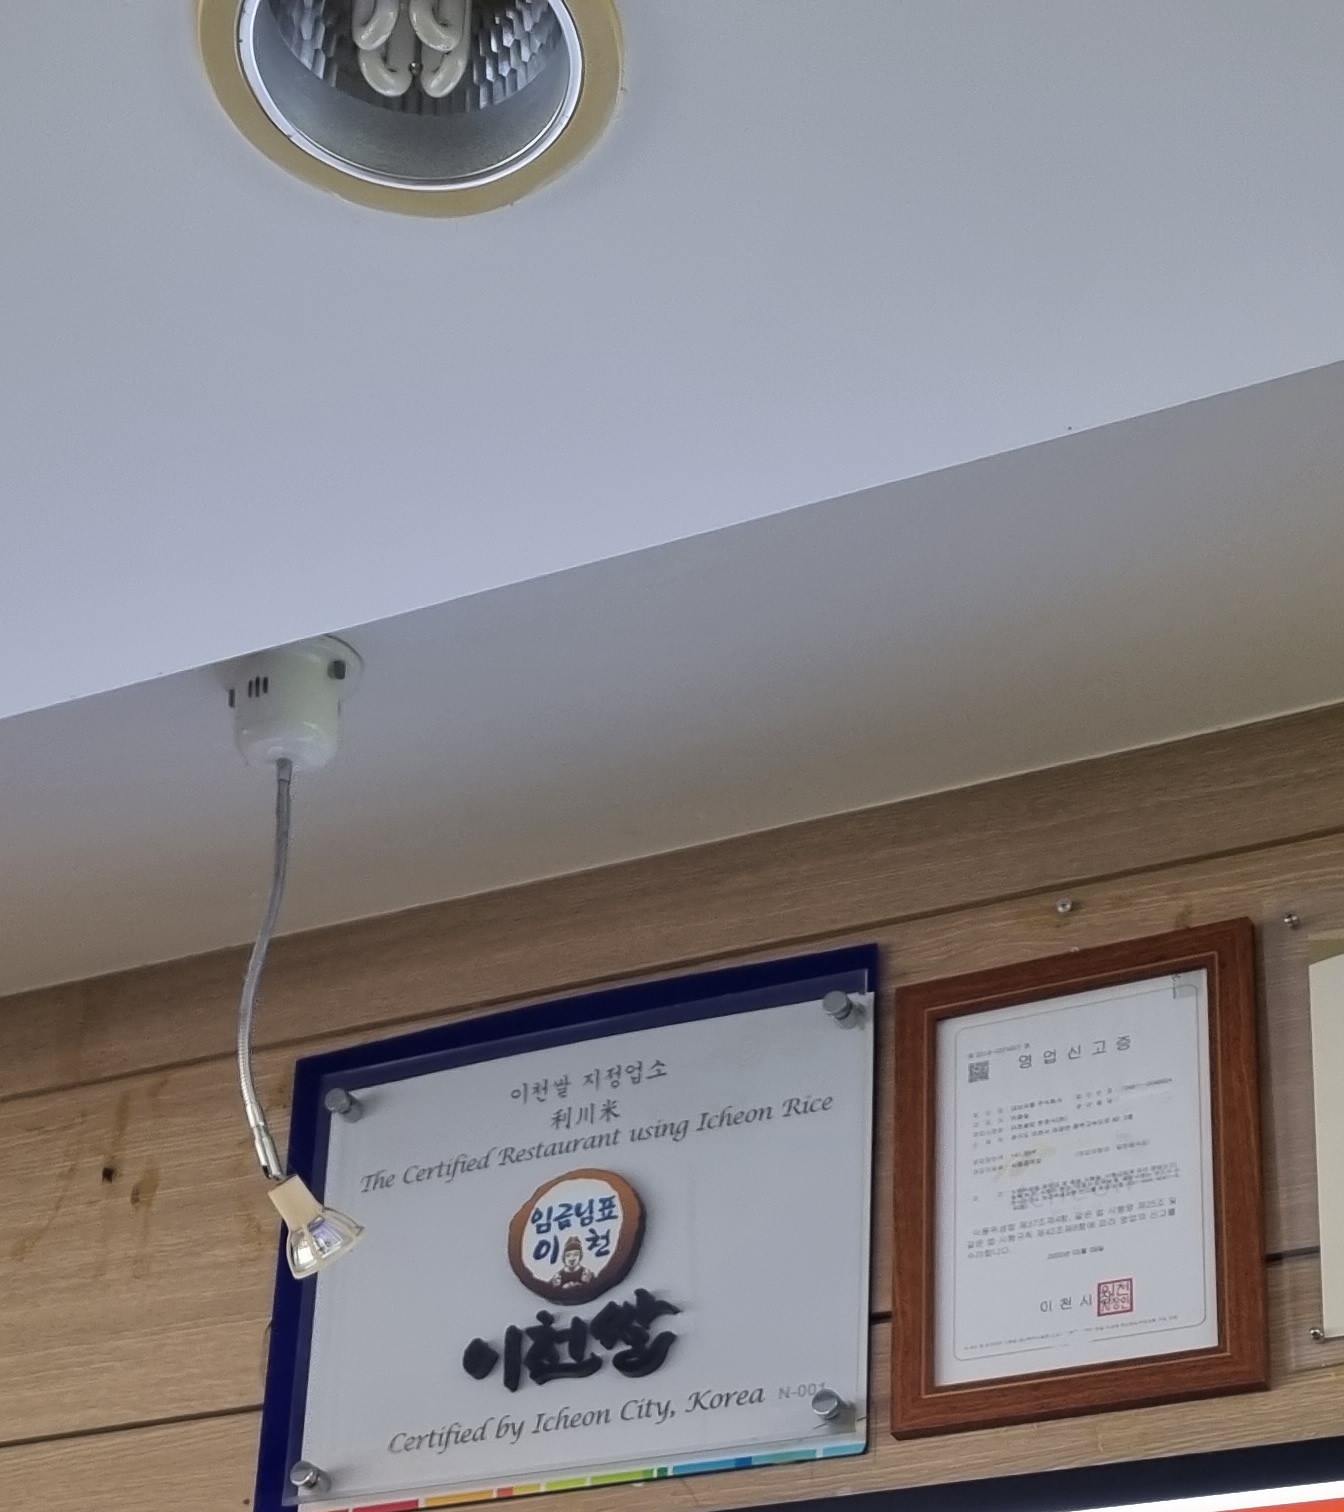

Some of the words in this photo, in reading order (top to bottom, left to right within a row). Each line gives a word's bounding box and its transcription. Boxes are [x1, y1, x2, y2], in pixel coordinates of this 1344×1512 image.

[510, 1076, 571, 1104] 이천쌀
[582, 1059, 667, 1090] 지정업소
[360, 1169, 396, 1193] The
[403, 1152, 490, 1188] Certified
[498, 1128, 621, 1167] Restaurant
[628, 1118, 688, 1145] using
[696, 1103, 773, 1134] Icheon
[782, 1092, 834, 1121] Rice
[550, 1101, 618, 1130] 利川米
[531, 1195, 619, 1235] 임금님표
[462, 1288, 681, 1391] 이천쌀
[387, 1421, 489, 1454] Certified
[494, 1412, 527, 1440] by
[532, 1405, 613, 1435] Icheon
[620, 1397, 677, 1423] City,
[684, 1385, 766, 1414] Korea
